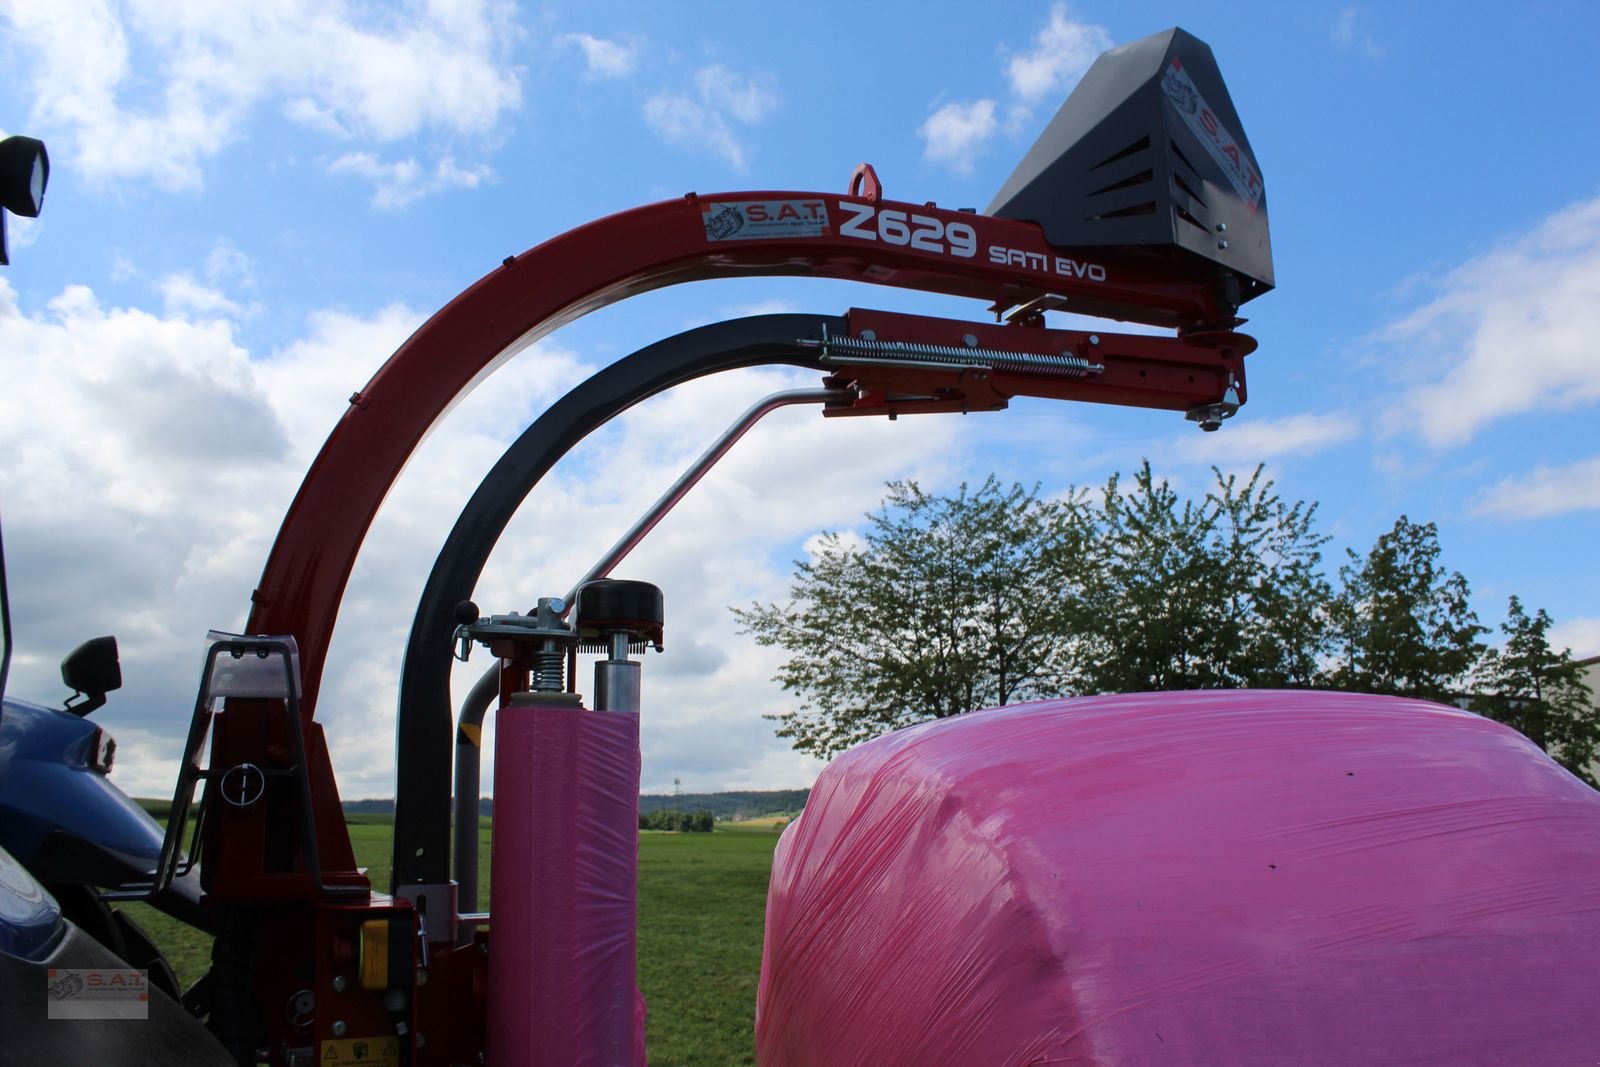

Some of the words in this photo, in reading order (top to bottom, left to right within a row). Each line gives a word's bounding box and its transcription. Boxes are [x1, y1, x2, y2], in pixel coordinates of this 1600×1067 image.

[745, 203, 825, 222] S.A.T.
[838, 200, 977, 258] Z629
[988, 245, 1048, 272] SATI
[1055, 256, 1106, 282] EVO
